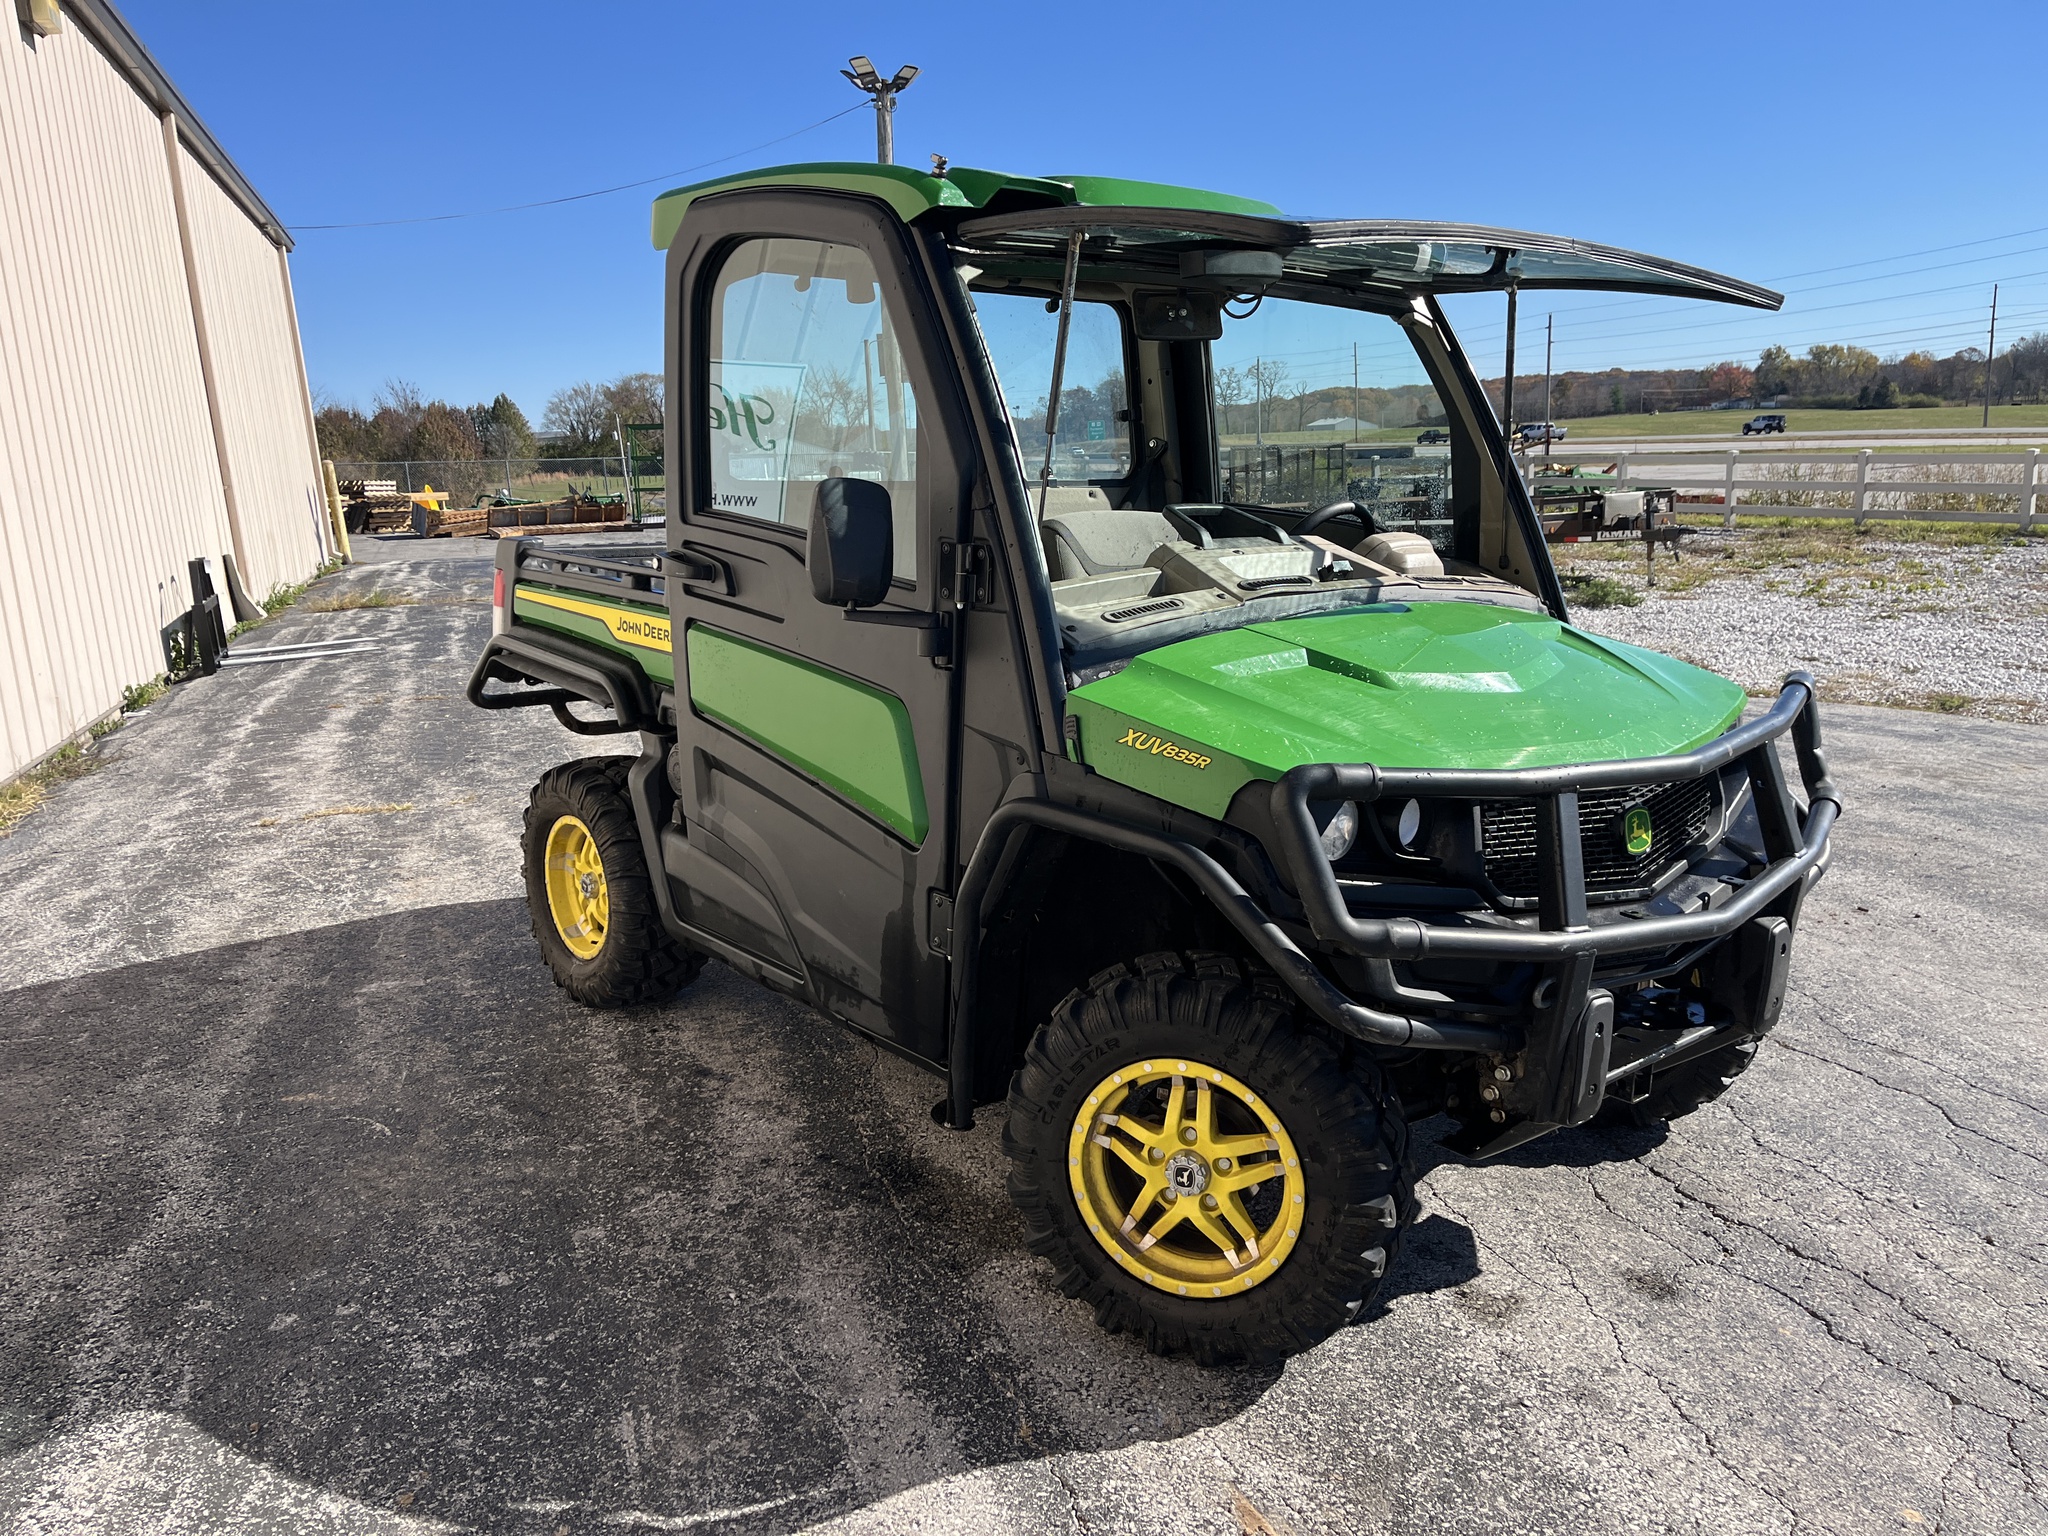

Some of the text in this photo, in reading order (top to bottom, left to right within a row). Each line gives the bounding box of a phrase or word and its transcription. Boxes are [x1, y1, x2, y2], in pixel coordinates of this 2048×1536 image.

[617, 617, 670, 642] JOHN DEER
[1116, 728, 1213, 769] XUV835R
[1041, 1037, 1121, 1125] CARLSTAR
